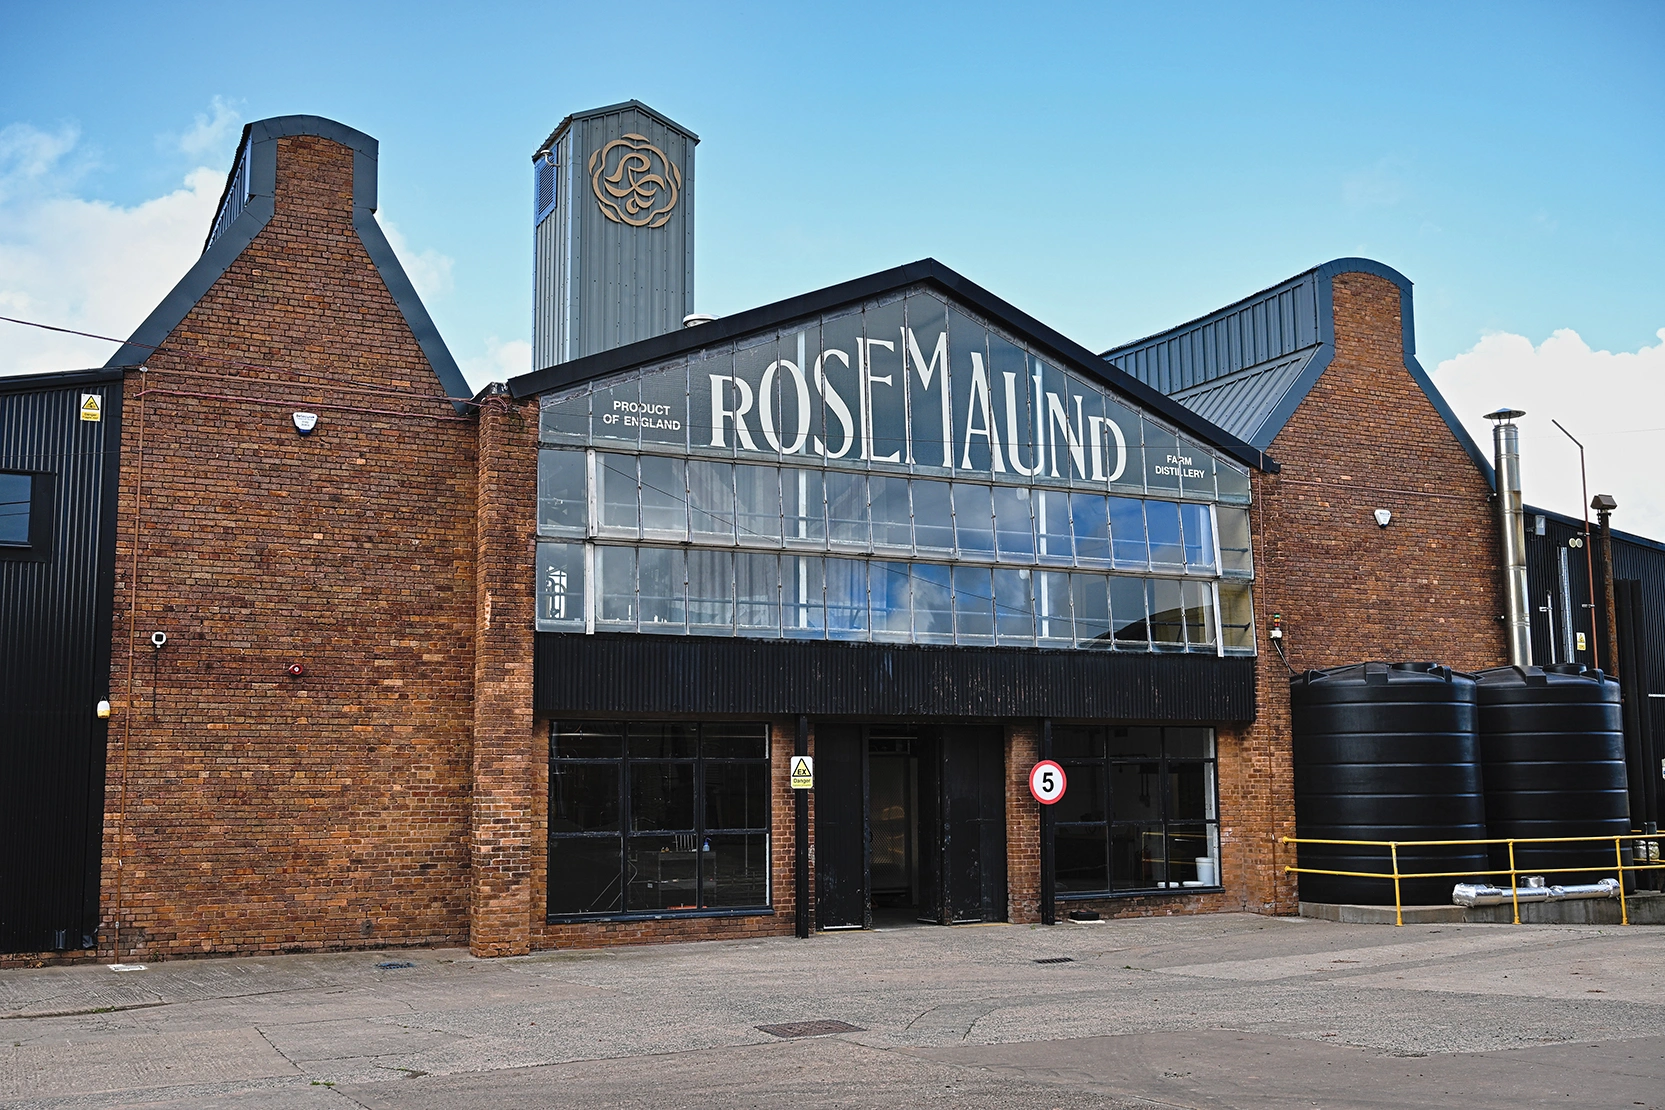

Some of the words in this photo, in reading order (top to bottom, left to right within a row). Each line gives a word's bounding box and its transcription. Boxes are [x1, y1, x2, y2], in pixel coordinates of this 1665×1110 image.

[613, 400, 670, 416] PRODUCT
[709, 327, 1127, 482] ROSEMAUND
[602, 413, 620, 425] OF
[624, 416, 680, 430] ENGLAND
[1166, 454, 1192, 466] FARM
[1155, 466, 1204, 478] DISTILLERY
[1042, 772, 1054, 793] 5
